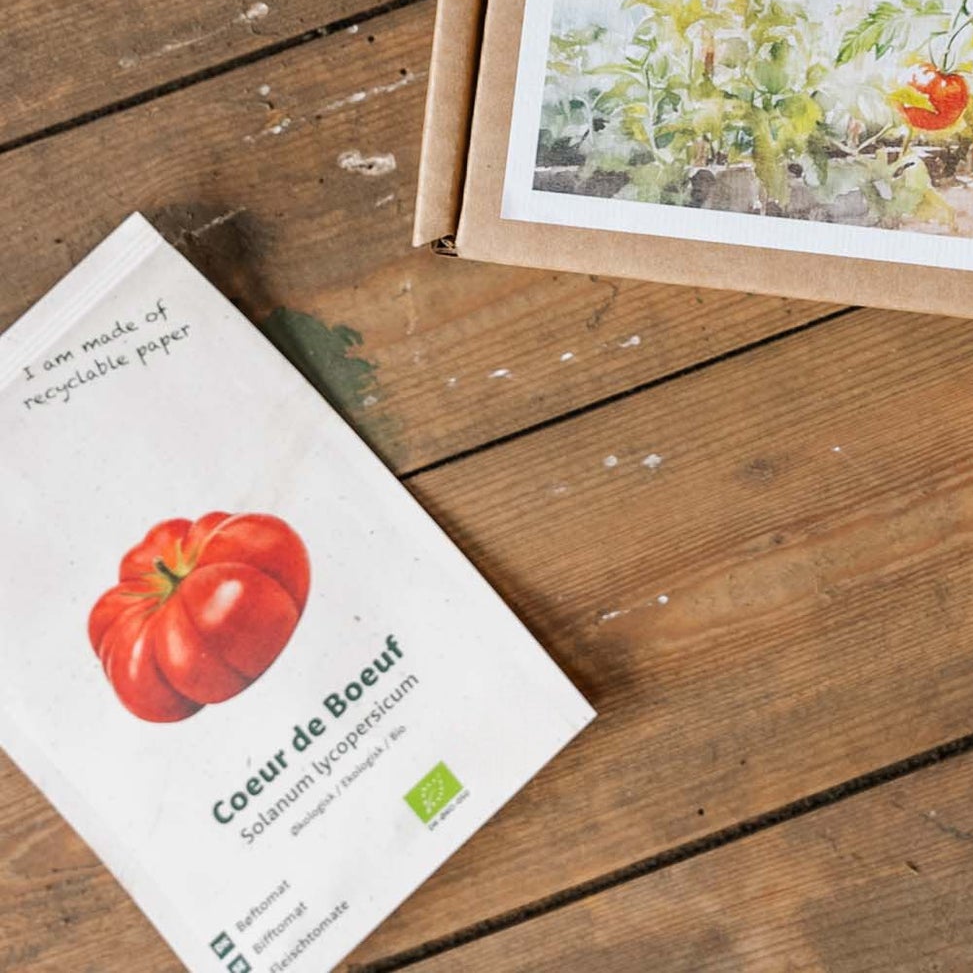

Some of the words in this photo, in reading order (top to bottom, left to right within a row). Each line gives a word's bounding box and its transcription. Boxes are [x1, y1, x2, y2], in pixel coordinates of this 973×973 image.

[22, 366, 36, 382] I
[43, 350, 74, 372] am
[82, 320, 140, 354] made
[145, 298, 167, 323] of
[22, 355, 130, 410] recyclable
[136, 324, 191, 366] paper
[212, 749, 289, 824] Coeur
[292, 716, 326, 752] de
[323, 634, 404, 718] Boeuf
[240, 774, 315, 845] Solanum
[312, 673, 420, 776] lycopersicum
[390, 725, 407, 741] Bio
[252, 902, 308, 955] Bifftomat
